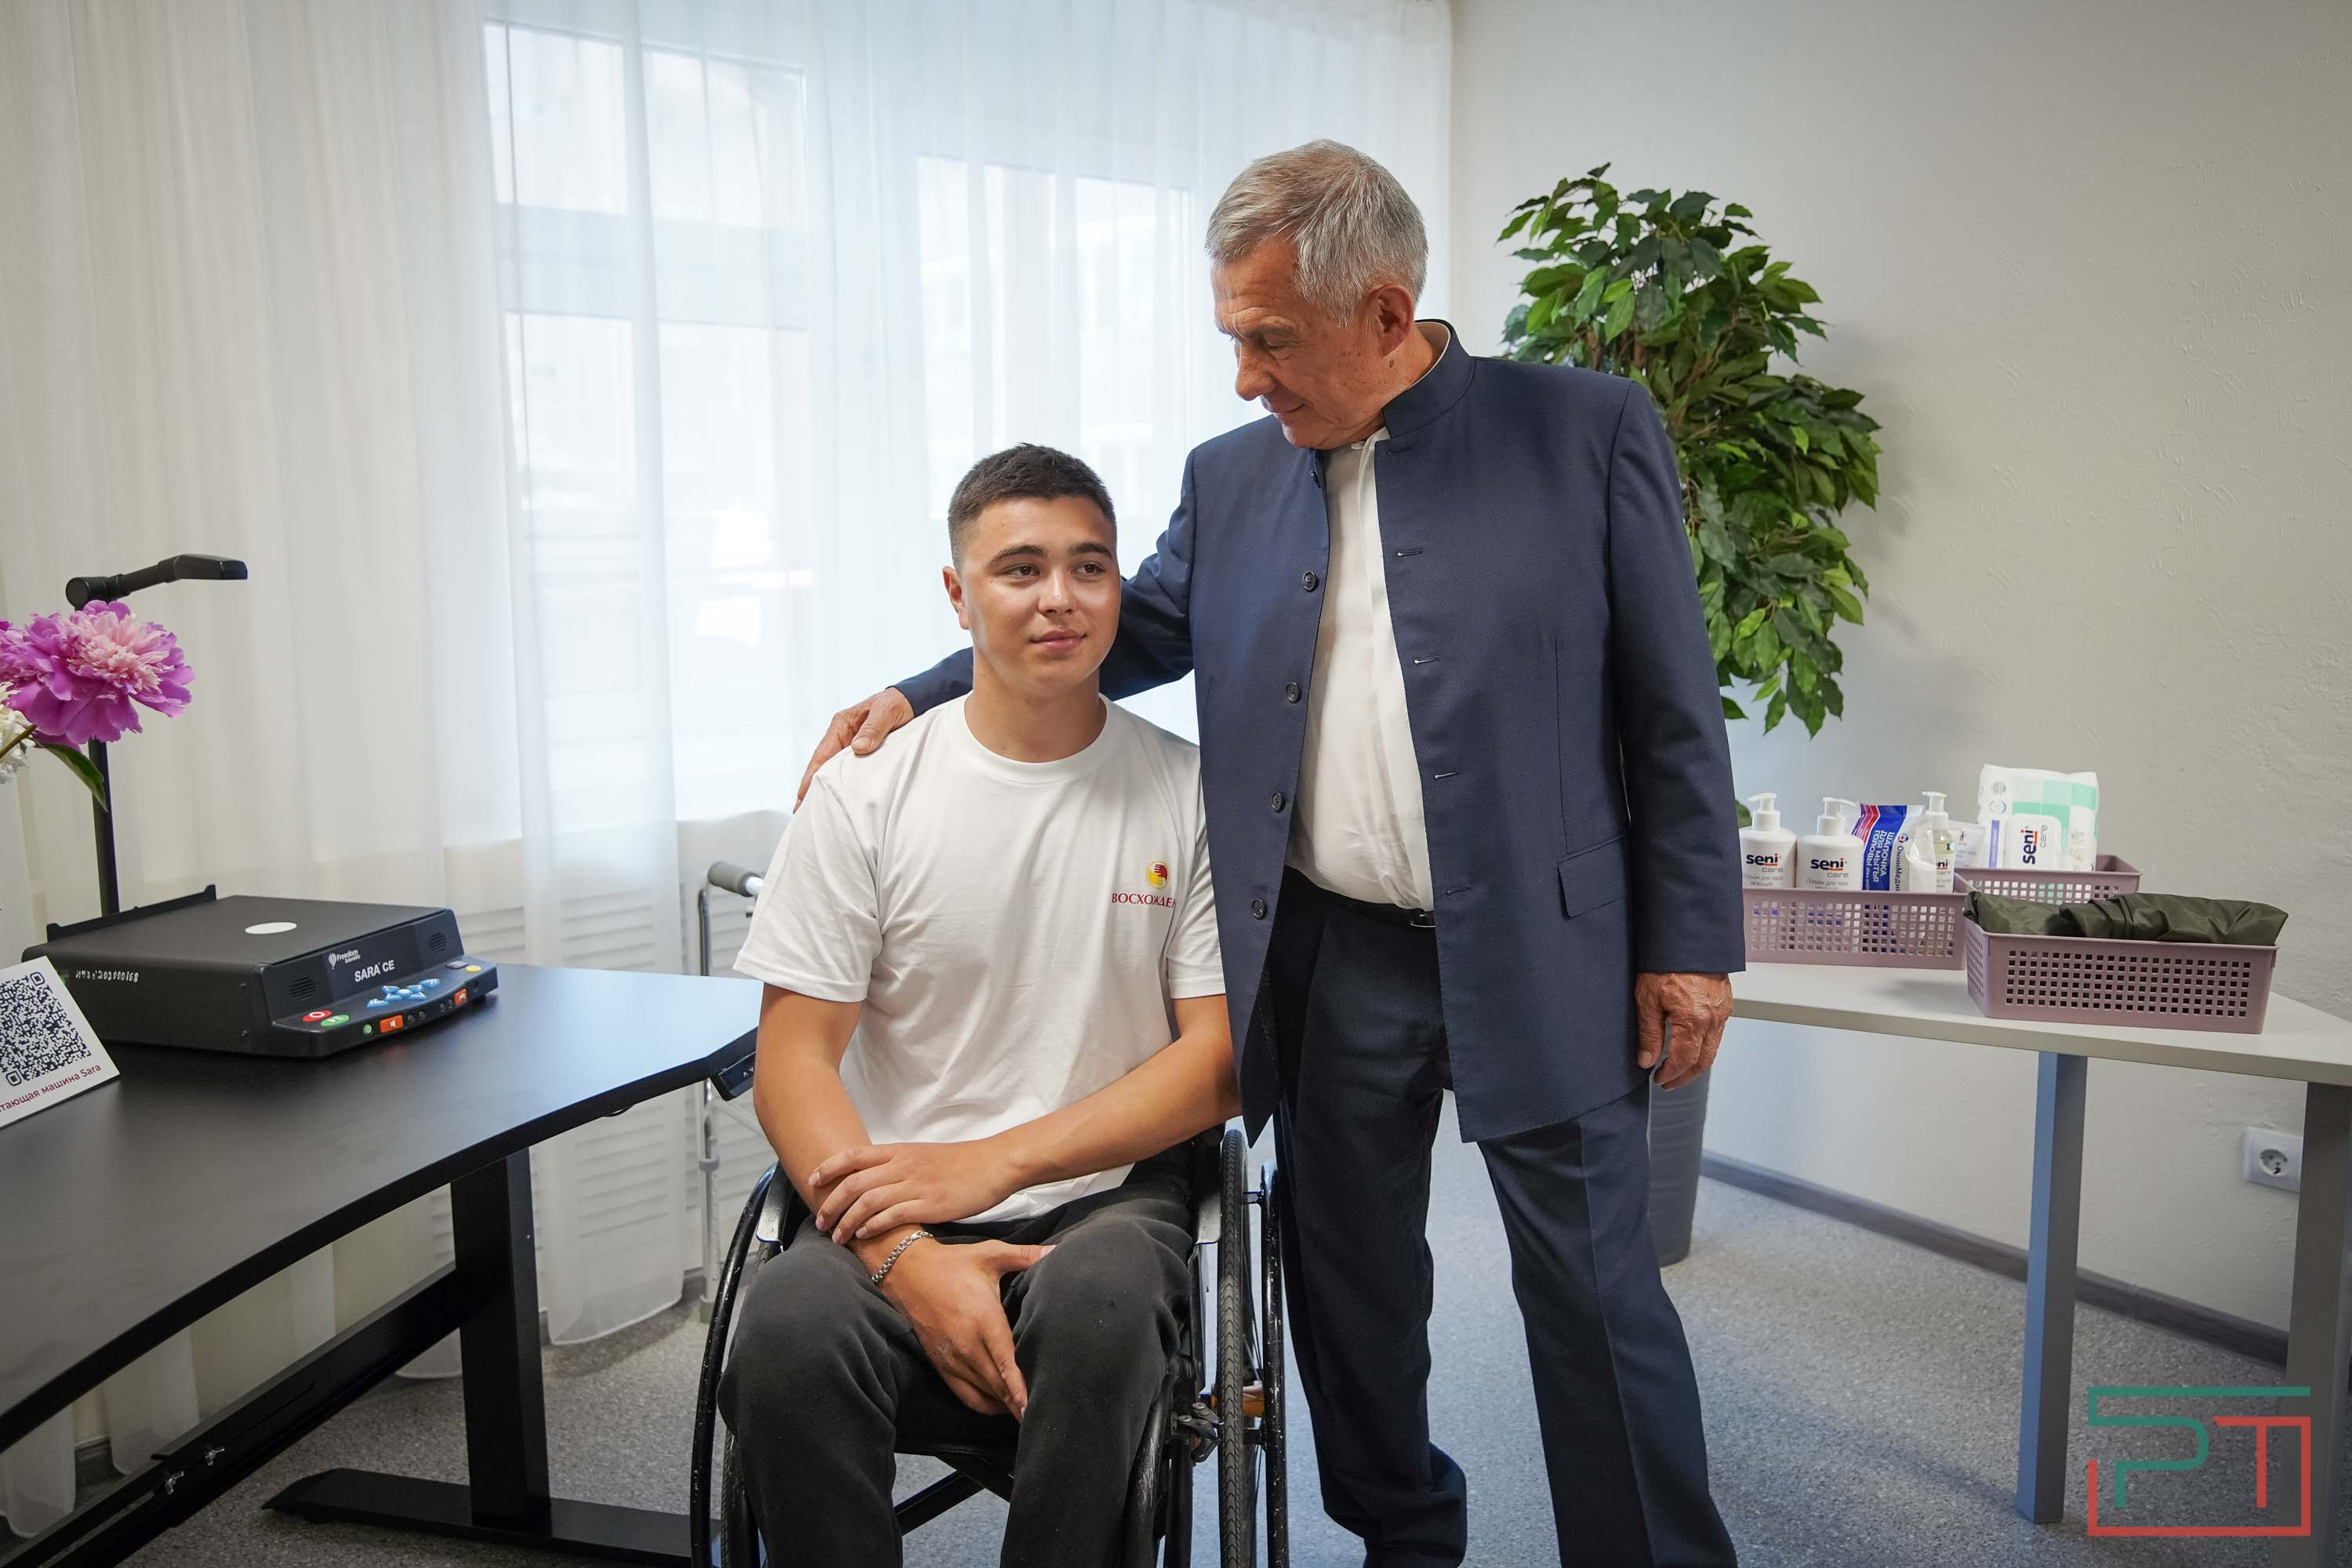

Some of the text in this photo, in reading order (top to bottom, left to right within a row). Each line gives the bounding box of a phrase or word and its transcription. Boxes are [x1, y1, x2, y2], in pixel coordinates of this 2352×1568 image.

[1746, 853, 1779, 866] seni
[1867, 829, 1880, 866] ГОЛОВЫ
[1872, 830, 1888, 883] ДЛЯ МЫТЬЯ
[1881, 831, 1895, 877] ШАПОЧКА
[2020, 829, 2038, 865] seni
[1810, 858, 1845, 871] seni
[337, 949, 358, 961] Freedom
[382, 960, 395, 972] CE
[41, 1073, 81, 1094] машина
[80, 1065, 101, 1077] Sara
